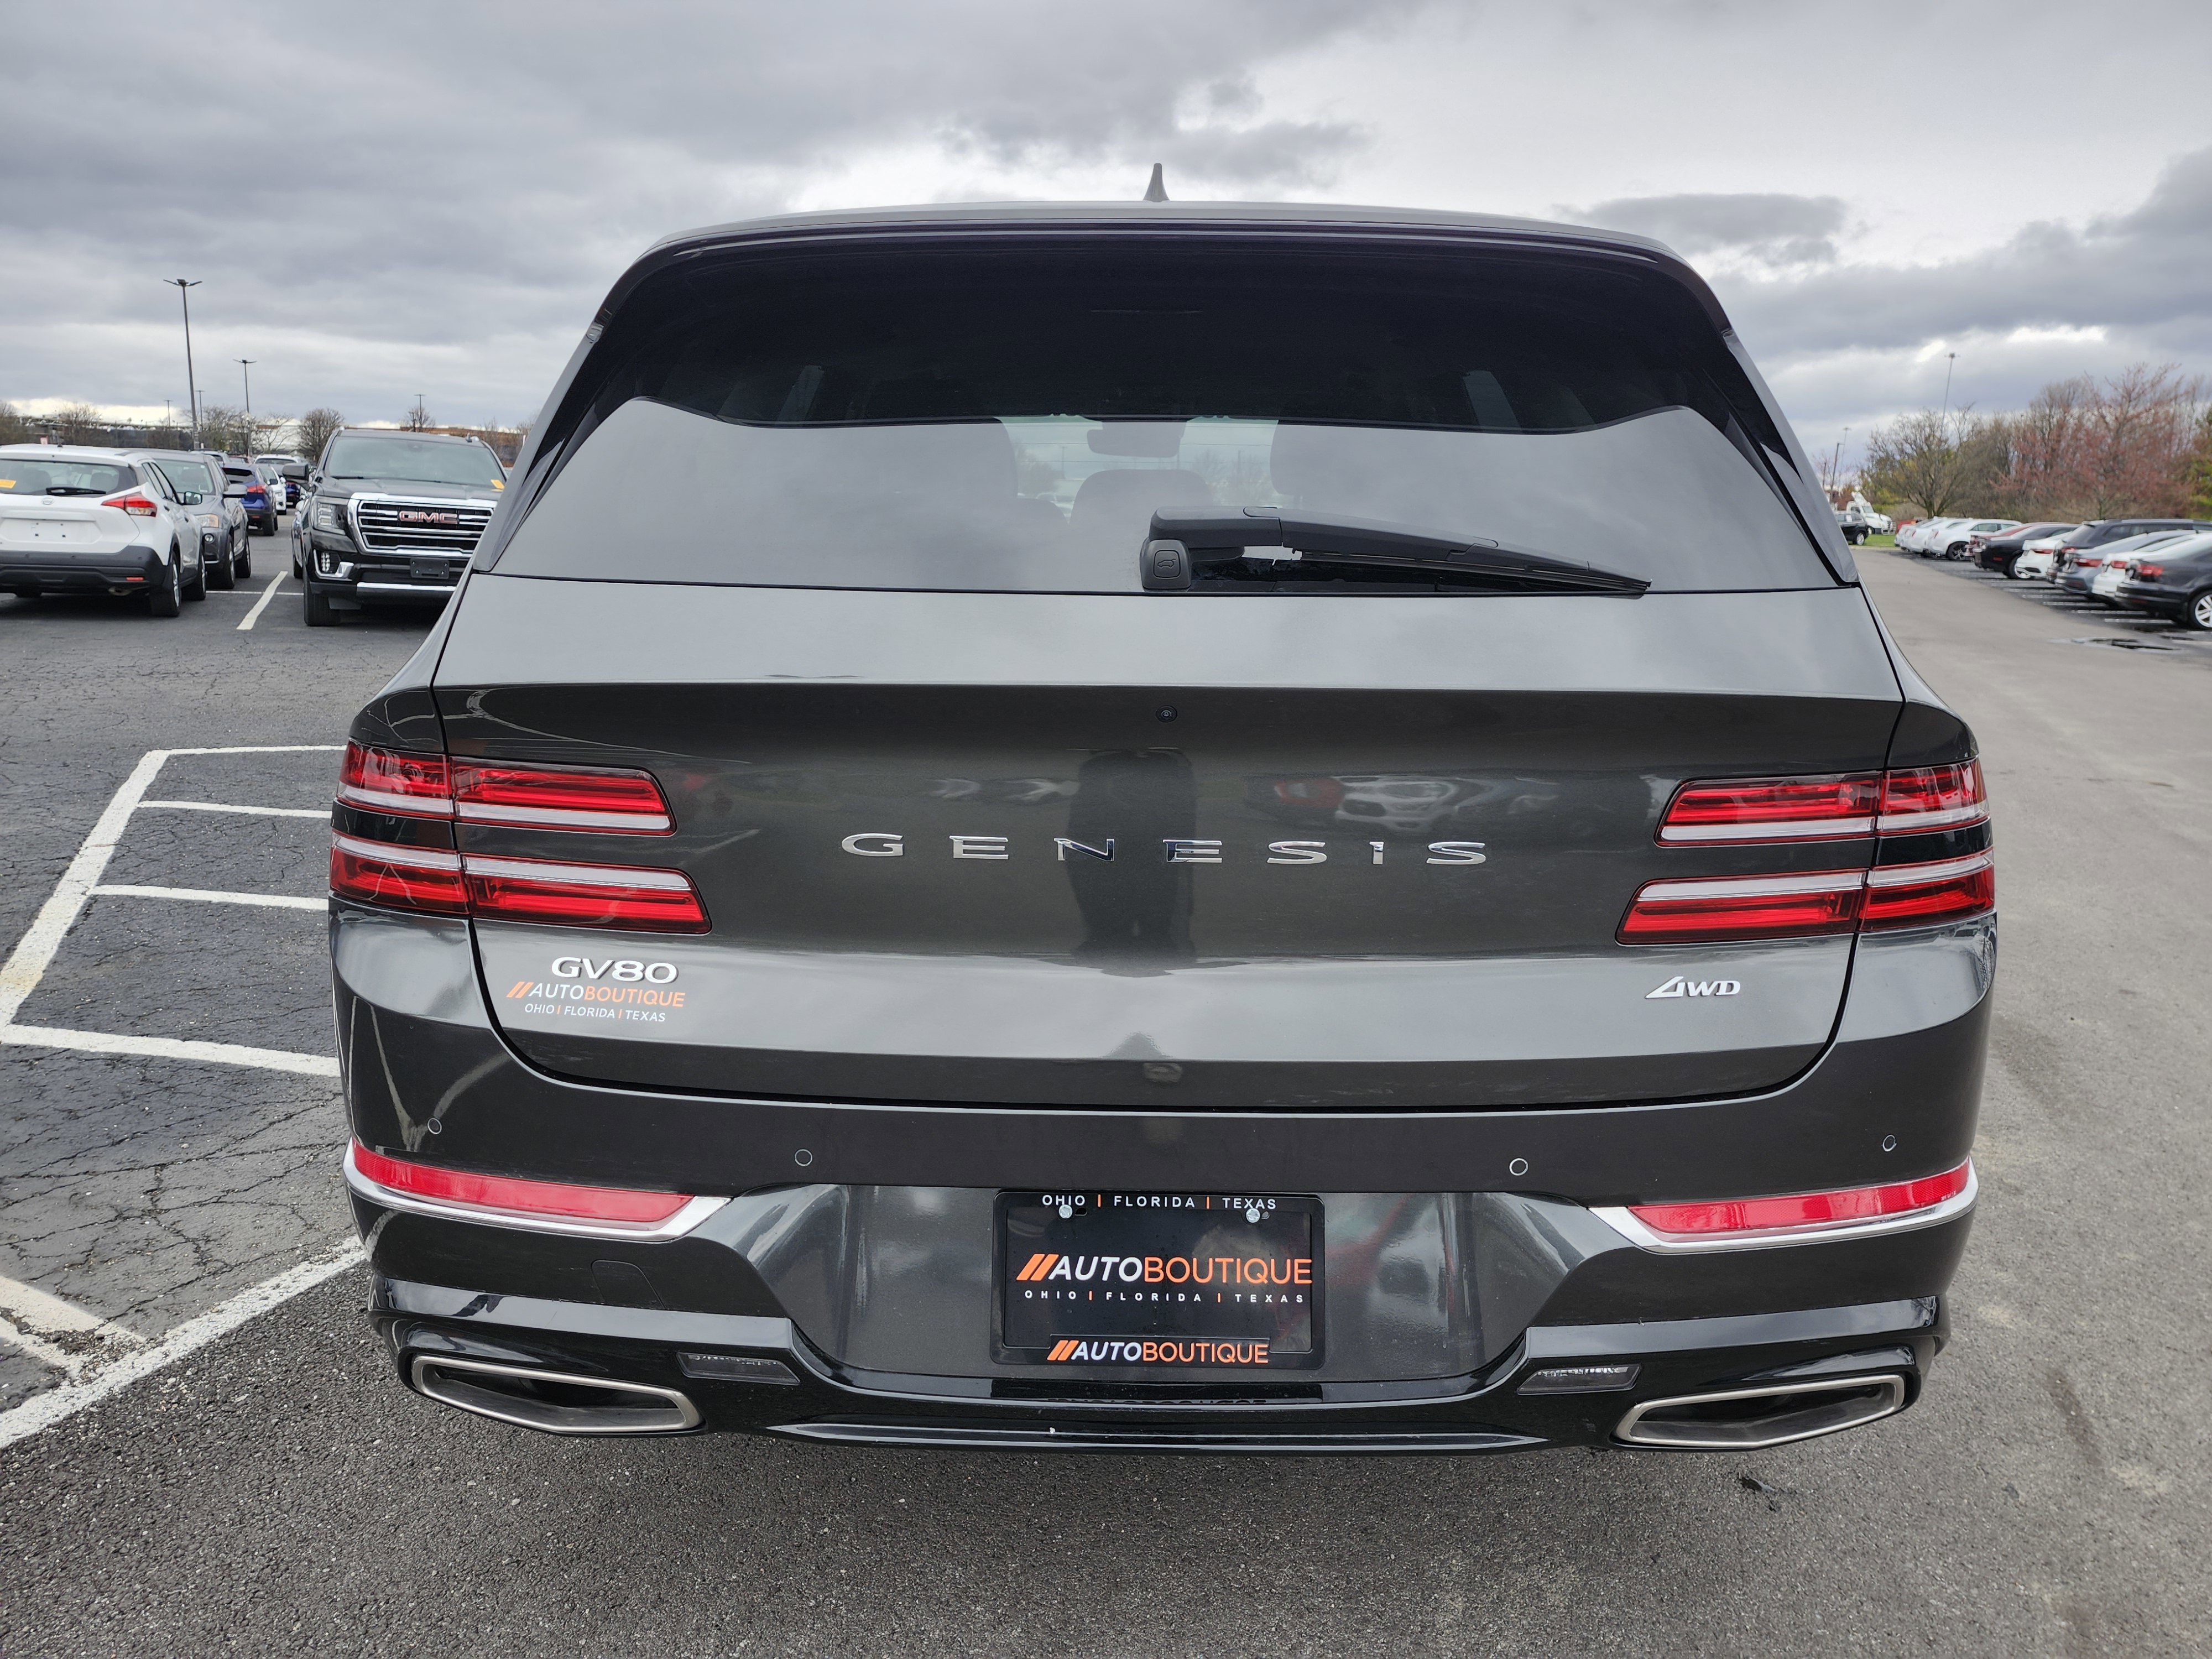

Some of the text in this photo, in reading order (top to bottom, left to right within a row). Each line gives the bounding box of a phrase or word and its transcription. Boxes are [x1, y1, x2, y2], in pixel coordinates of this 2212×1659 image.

[399, 510, 458, 524] GMC
[841, 833, 1486, 865] GENESIS
[551, 957, 679, 984] GV80
[528, 983, 686, 1008] AUTOBOUTIQUE
[525, 1003, 666, 1022] OHIO FLORIDA TEXAS
[1042, 1194, 1276, 1209] OHIO FLORIDA TEXAS
[1048, 1256, 1313, 1285] AUTOBOUTIQUE
[1025, 1290, 1303, 1303] OHIO FLORIDA TEXAS
[1071, 1341, 1269, 1364] AUTOBOUTIQUE
